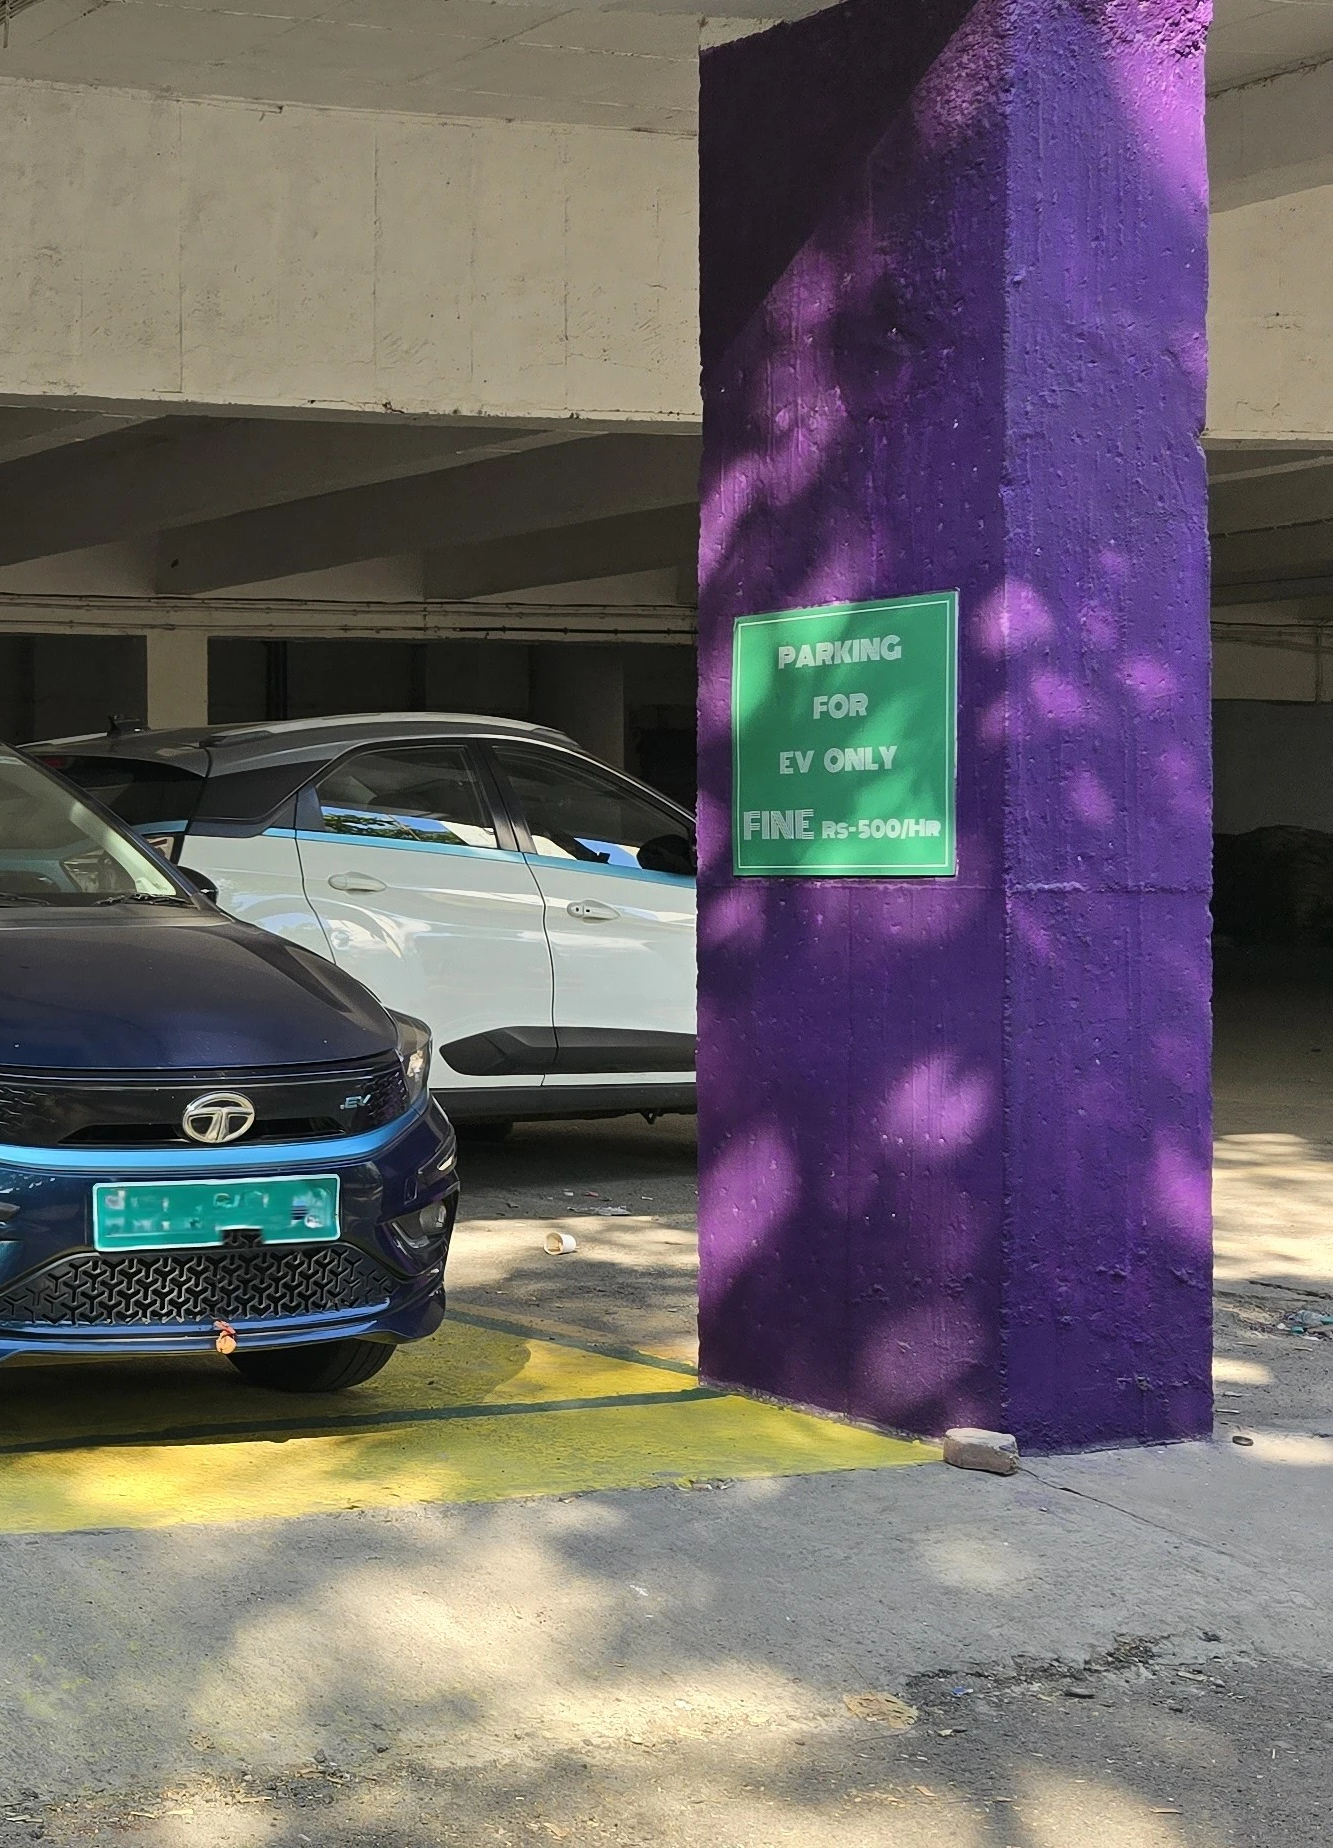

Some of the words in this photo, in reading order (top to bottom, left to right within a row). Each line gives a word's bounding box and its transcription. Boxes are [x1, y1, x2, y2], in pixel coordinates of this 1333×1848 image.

[778, 635, 902, 669] PARKING
[813, 693, 868, 720] FOR
[780, 750, 814, 774] EV
[824, 746, 898, 772] ONLY
[743, 809, 814, 840] FINE
